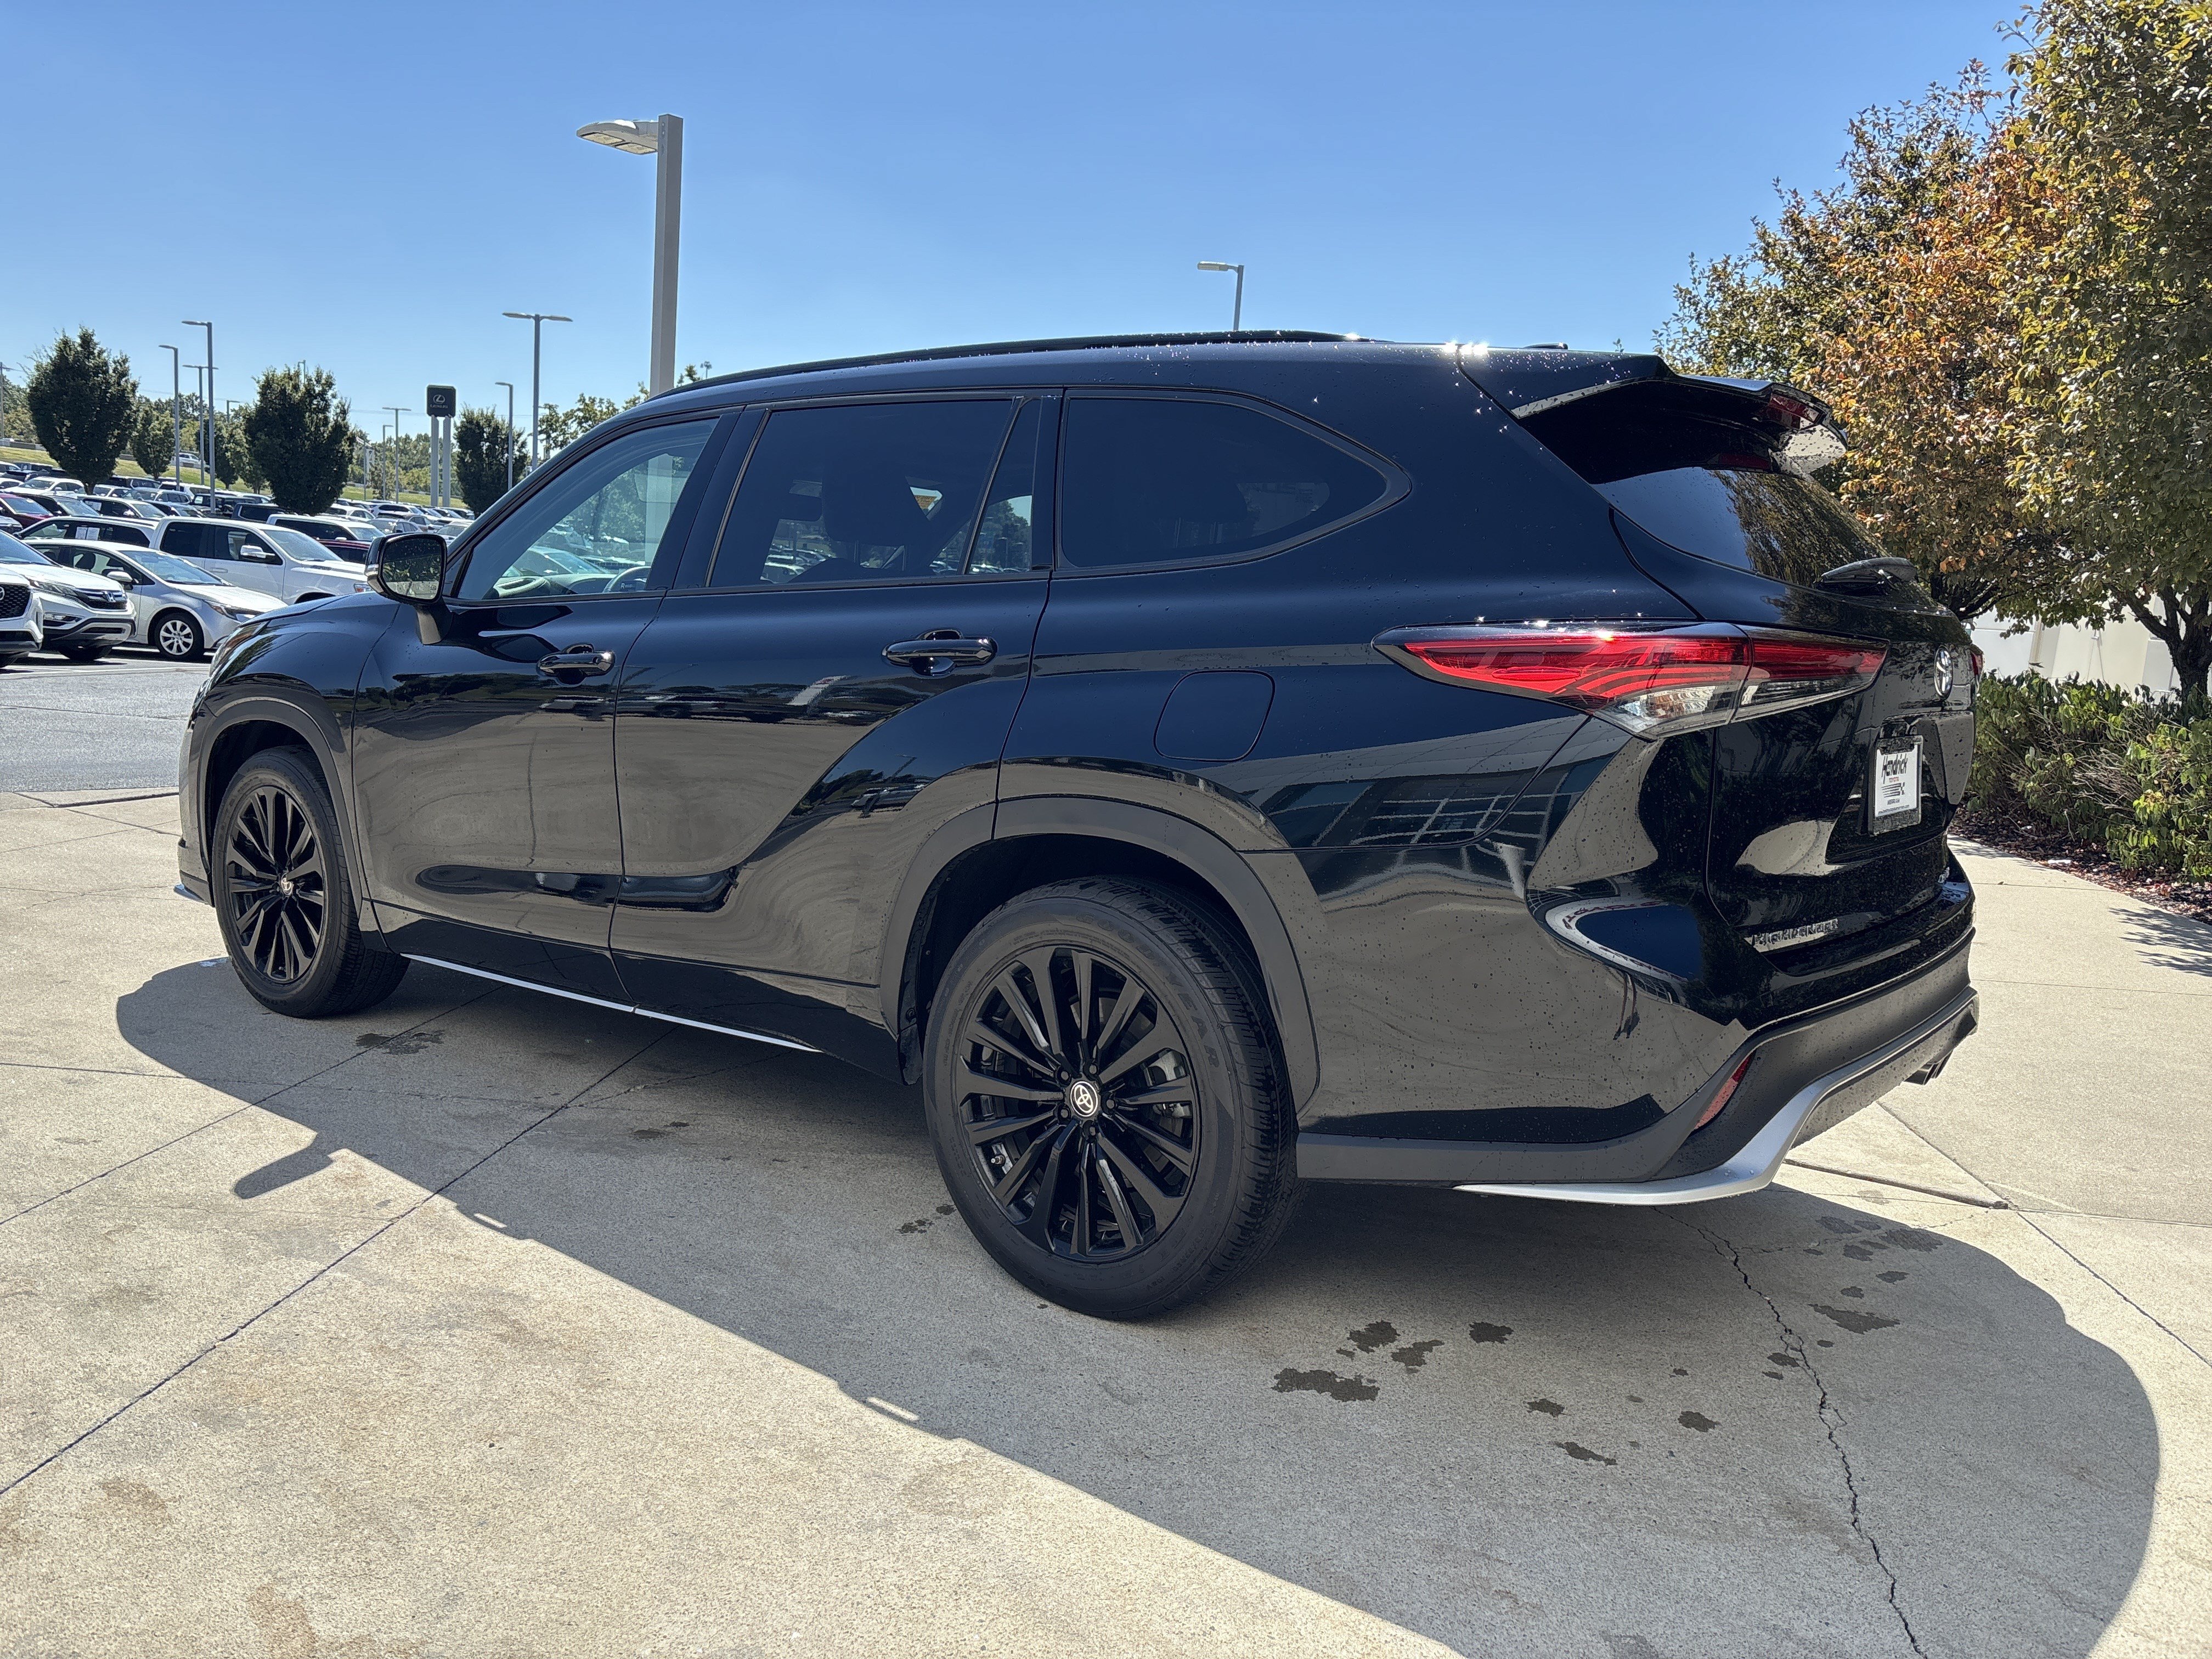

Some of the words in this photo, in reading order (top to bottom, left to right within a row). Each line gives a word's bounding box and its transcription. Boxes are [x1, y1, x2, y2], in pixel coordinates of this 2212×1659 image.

[1881, 753, 1908, 784] Hendrick
[1751, 918, 1838, 945] HIGHLANDER
[1075, 912, 1220, 1068] GOODYEAR
